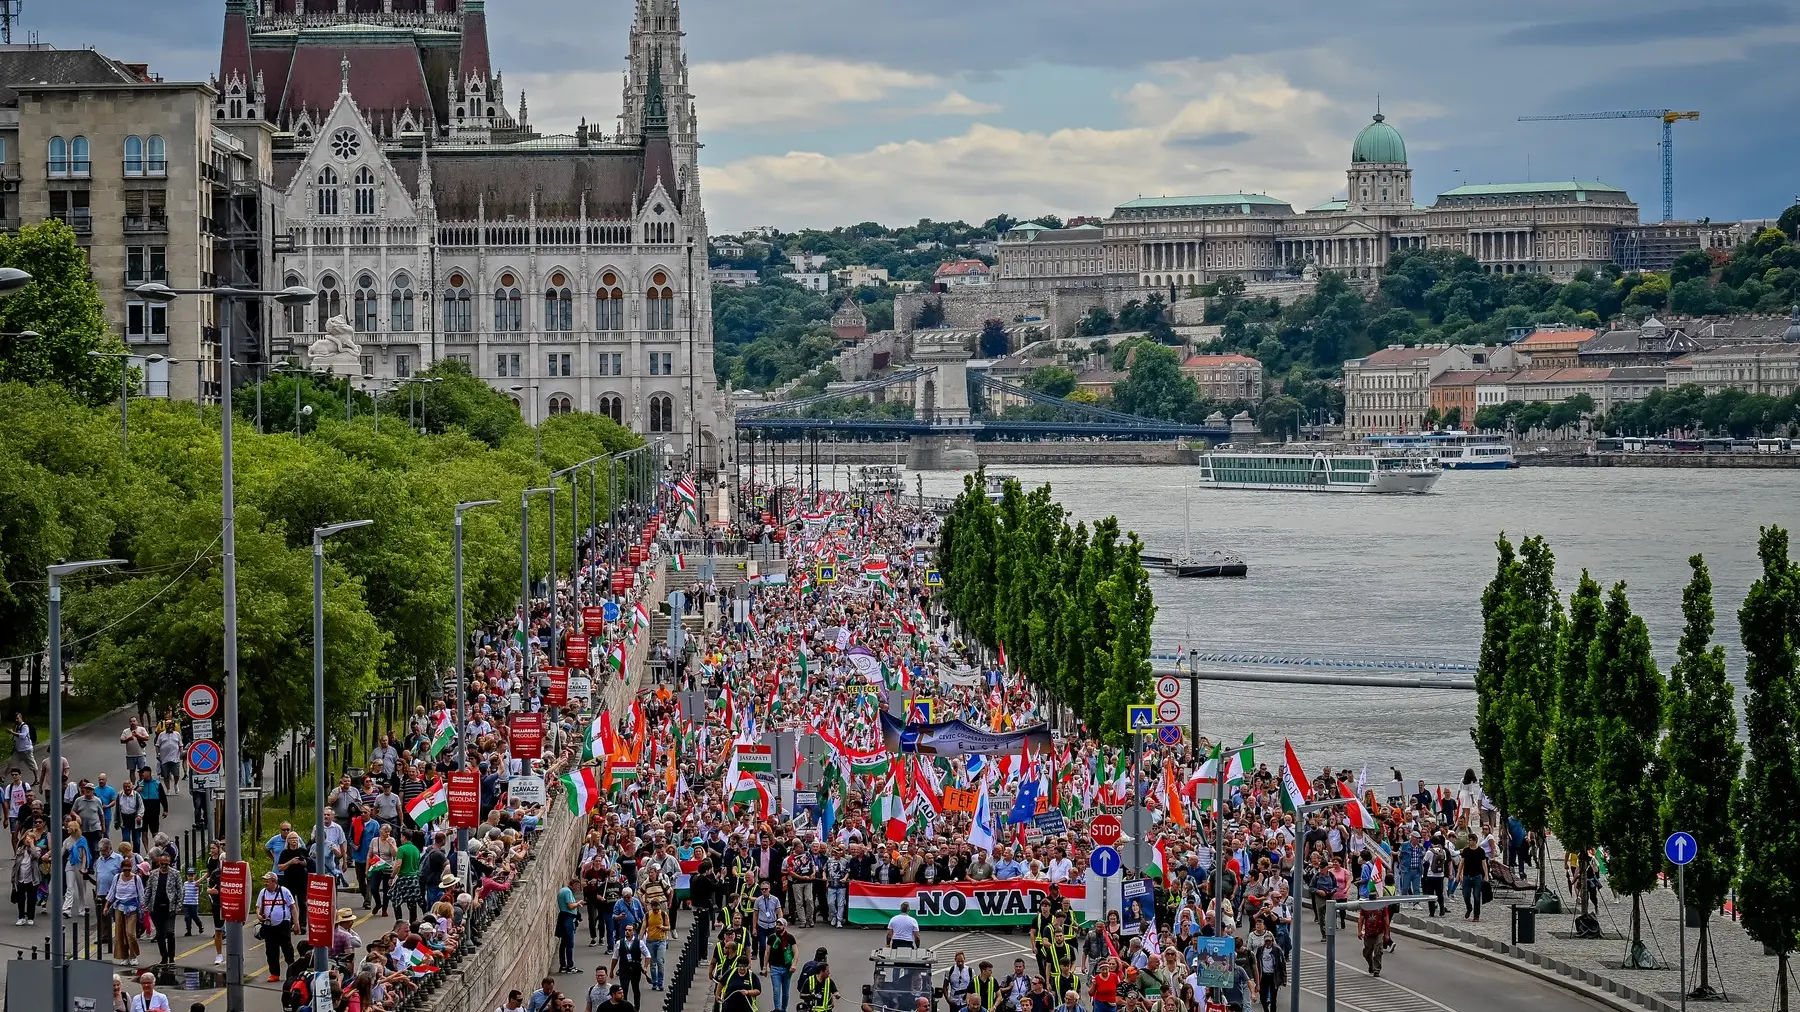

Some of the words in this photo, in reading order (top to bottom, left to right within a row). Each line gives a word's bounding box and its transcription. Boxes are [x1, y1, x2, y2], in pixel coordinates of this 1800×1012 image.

[1163, 683, 1175, 693] 40
[1092, 824, 1119, 836] STOP
[917, 890, 967, 916] NO
